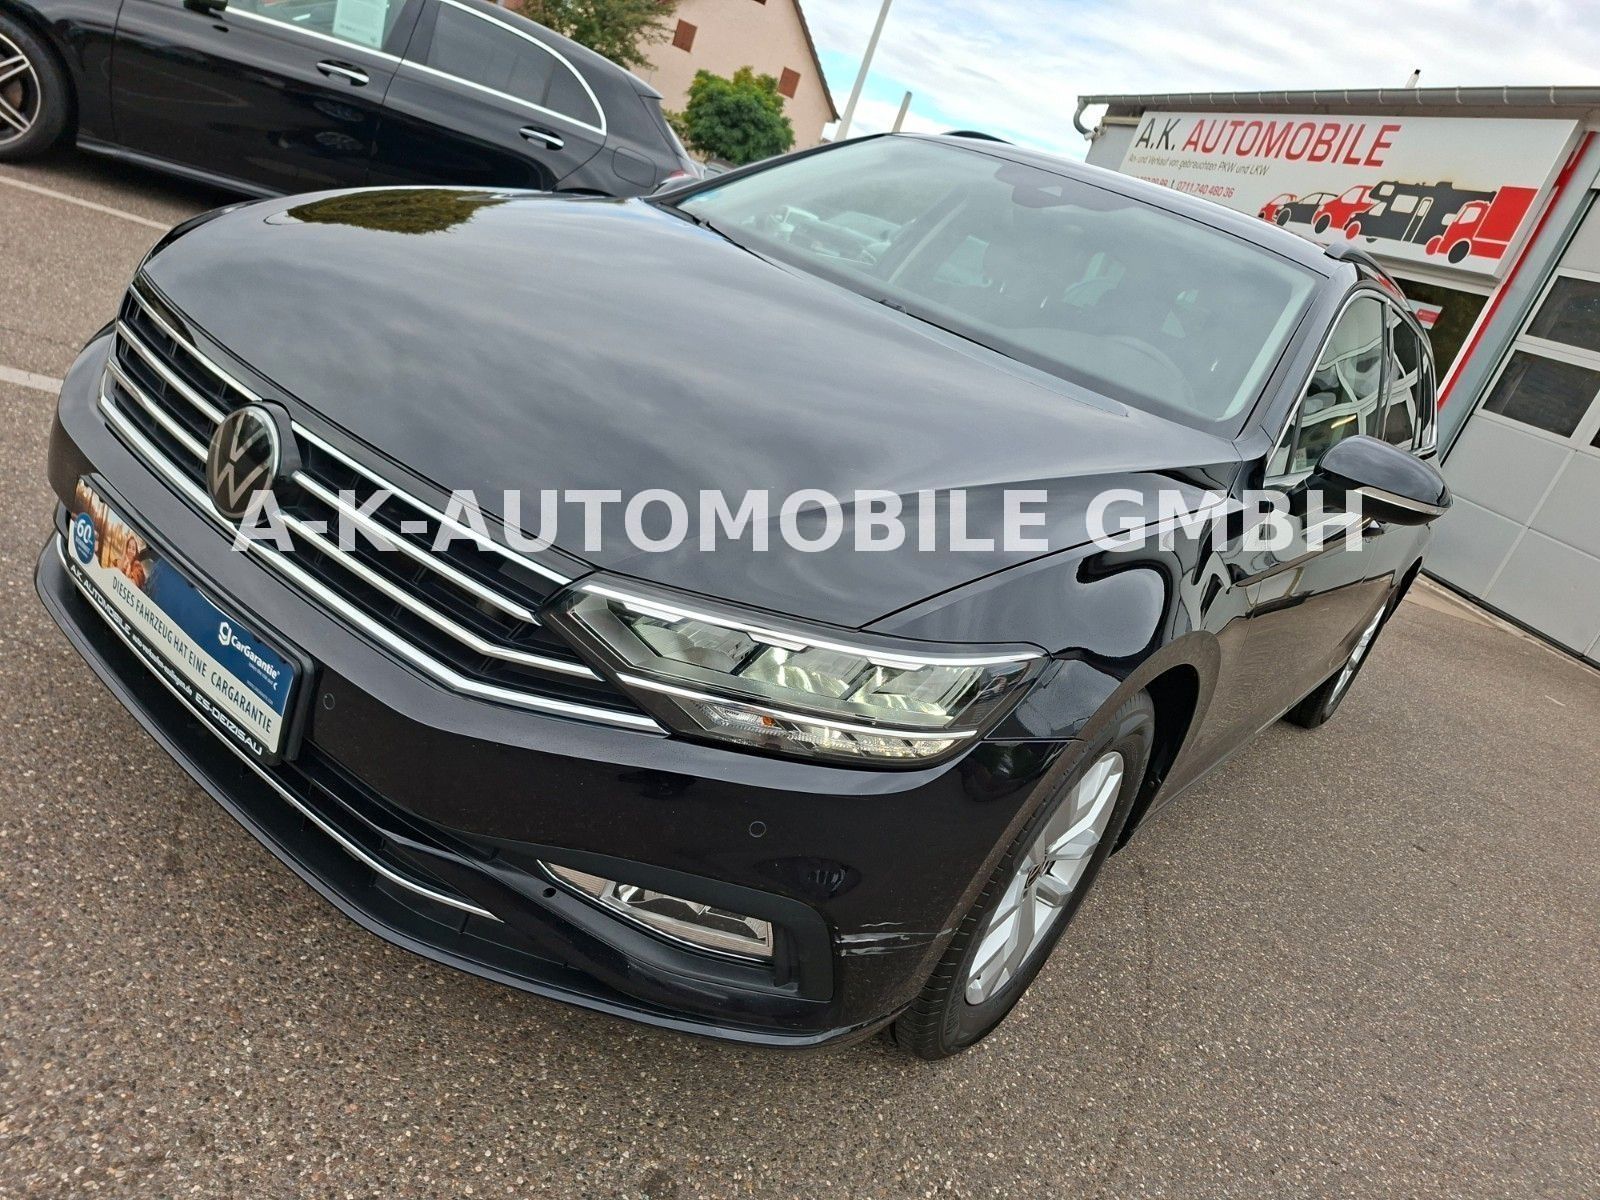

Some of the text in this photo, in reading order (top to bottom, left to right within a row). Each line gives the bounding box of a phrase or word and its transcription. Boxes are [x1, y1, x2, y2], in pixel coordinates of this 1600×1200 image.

[1135, 118, 1402, 167] A.K. AUTOMOBILE
[1218, 161, 1236, 173] PKW
[1235, 163, 1250, 175] und
[1249, 164, 1270, 176] LKW
[77, 518, 92, 544] 60
[83, 579, 132, 636] AUTOMOBILE
[112, 576, 135, 607] DIESES
[135, 599, 173, 644] FAHRZEUG
[173, 635, 188, 659] HAT
[188, 650, 208, 677] EINE
[210, 671, 273, 734] CARGARANTIE
[194, 692, 263, 756] ES-DEIZISAU
